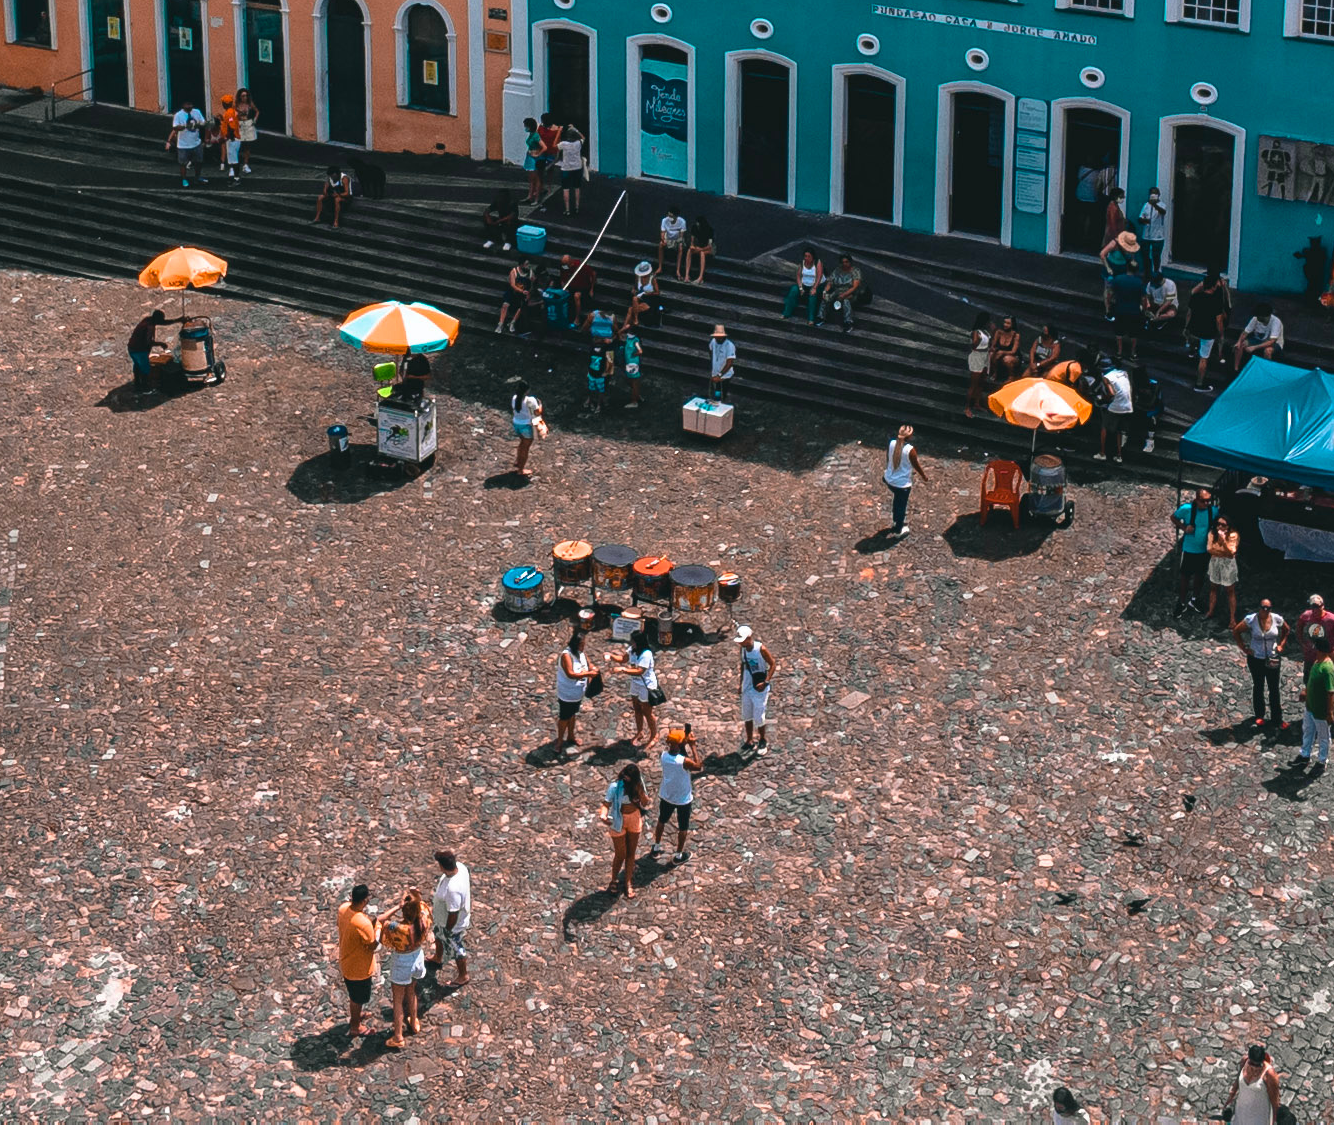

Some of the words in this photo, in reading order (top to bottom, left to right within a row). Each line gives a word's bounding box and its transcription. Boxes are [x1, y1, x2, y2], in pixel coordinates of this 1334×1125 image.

[945, 15, 978, 28] CASA
[1003, 23, 1044, 37] JORGE
[1053, 30, 1096, 44] AMADO
